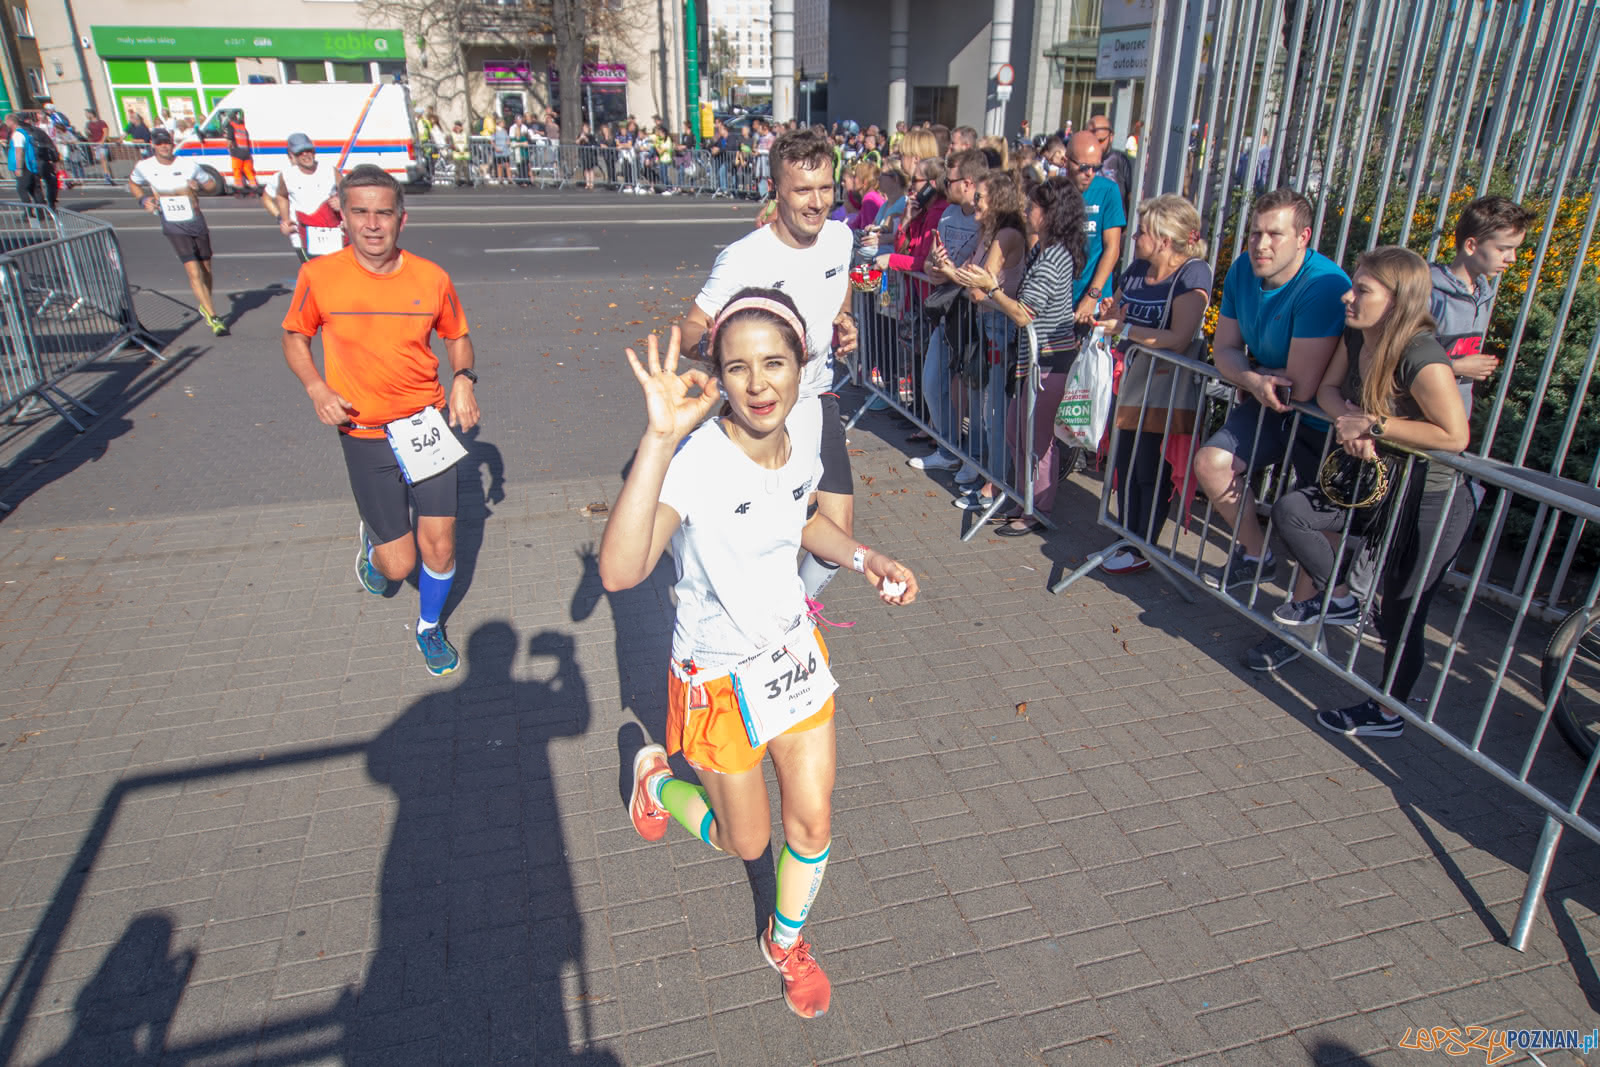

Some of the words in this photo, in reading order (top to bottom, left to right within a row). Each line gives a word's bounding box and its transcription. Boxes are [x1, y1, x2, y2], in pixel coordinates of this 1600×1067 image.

[1114, 39, 1146, 52] Dworzec
[410, 427, 441, 452] 549
[734, 501, 751, 514] 4F
[764, 651, 817, 699] 3746
